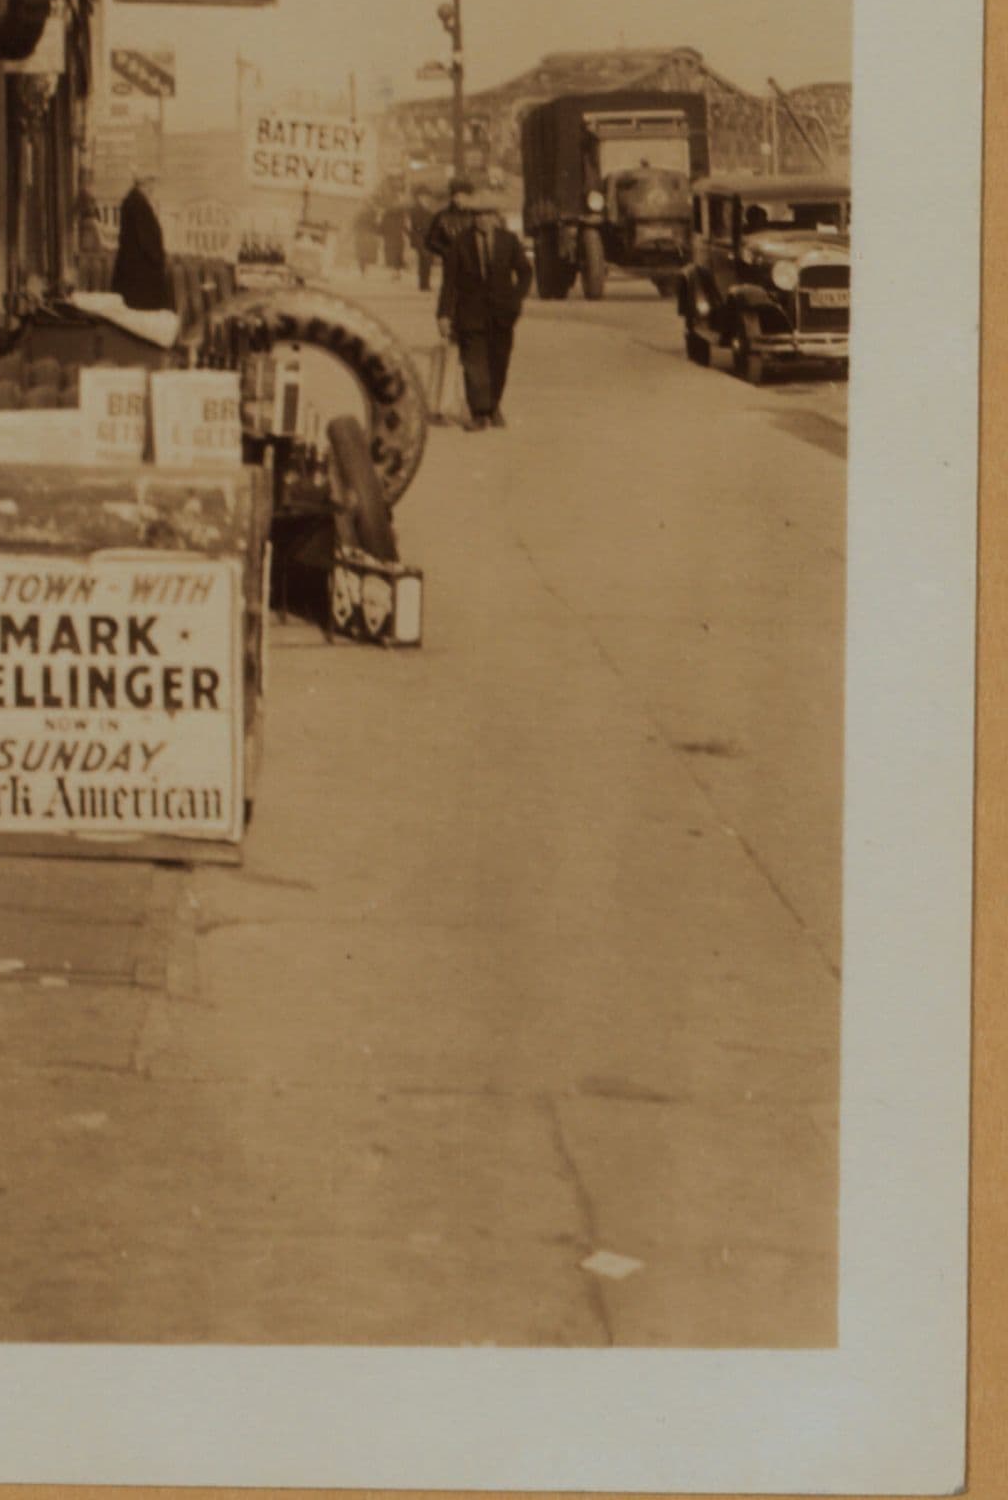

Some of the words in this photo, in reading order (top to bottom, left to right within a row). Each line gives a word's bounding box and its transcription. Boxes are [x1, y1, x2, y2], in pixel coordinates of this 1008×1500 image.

[256, 117, 367, 152] BATTERY
[252, 151, 365, 187] SERVICE
[0, 573, 98, 604] TOWN
[130, 572, 216, 604] WITH
[42, 776, 224, 821] American
